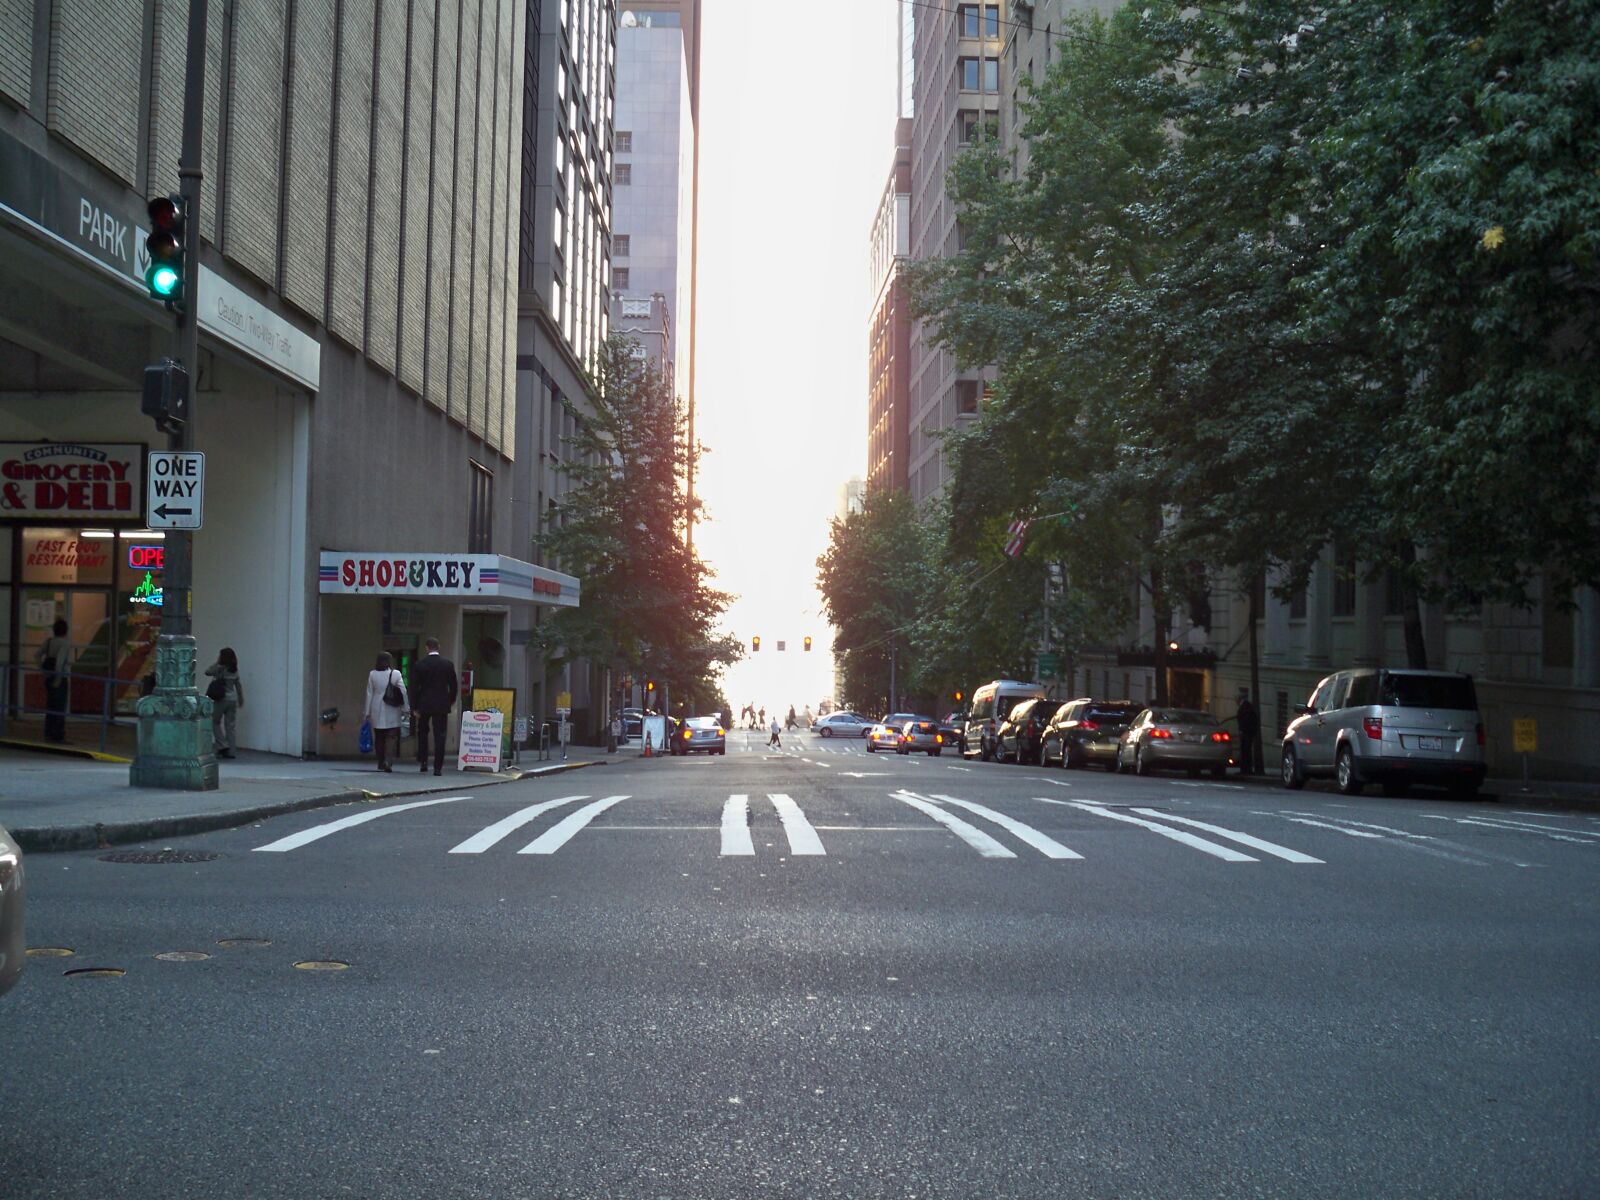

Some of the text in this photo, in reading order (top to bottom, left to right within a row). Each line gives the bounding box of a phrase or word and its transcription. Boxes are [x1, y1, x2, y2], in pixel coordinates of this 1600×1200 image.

[80, 198, 127, 262] PARK
[25, 445, 106, 460] COMMUNITY
[1, 460, 130, 480] GROCERY
[155, 458, 197, 476] ONE
[1, 481, 131, 511] & DELI
[154, 480, 197, 497] WAY
[36, 540, 101, 553] FAST FOOD
[27, 553, 108, 567] RESTAURANT
